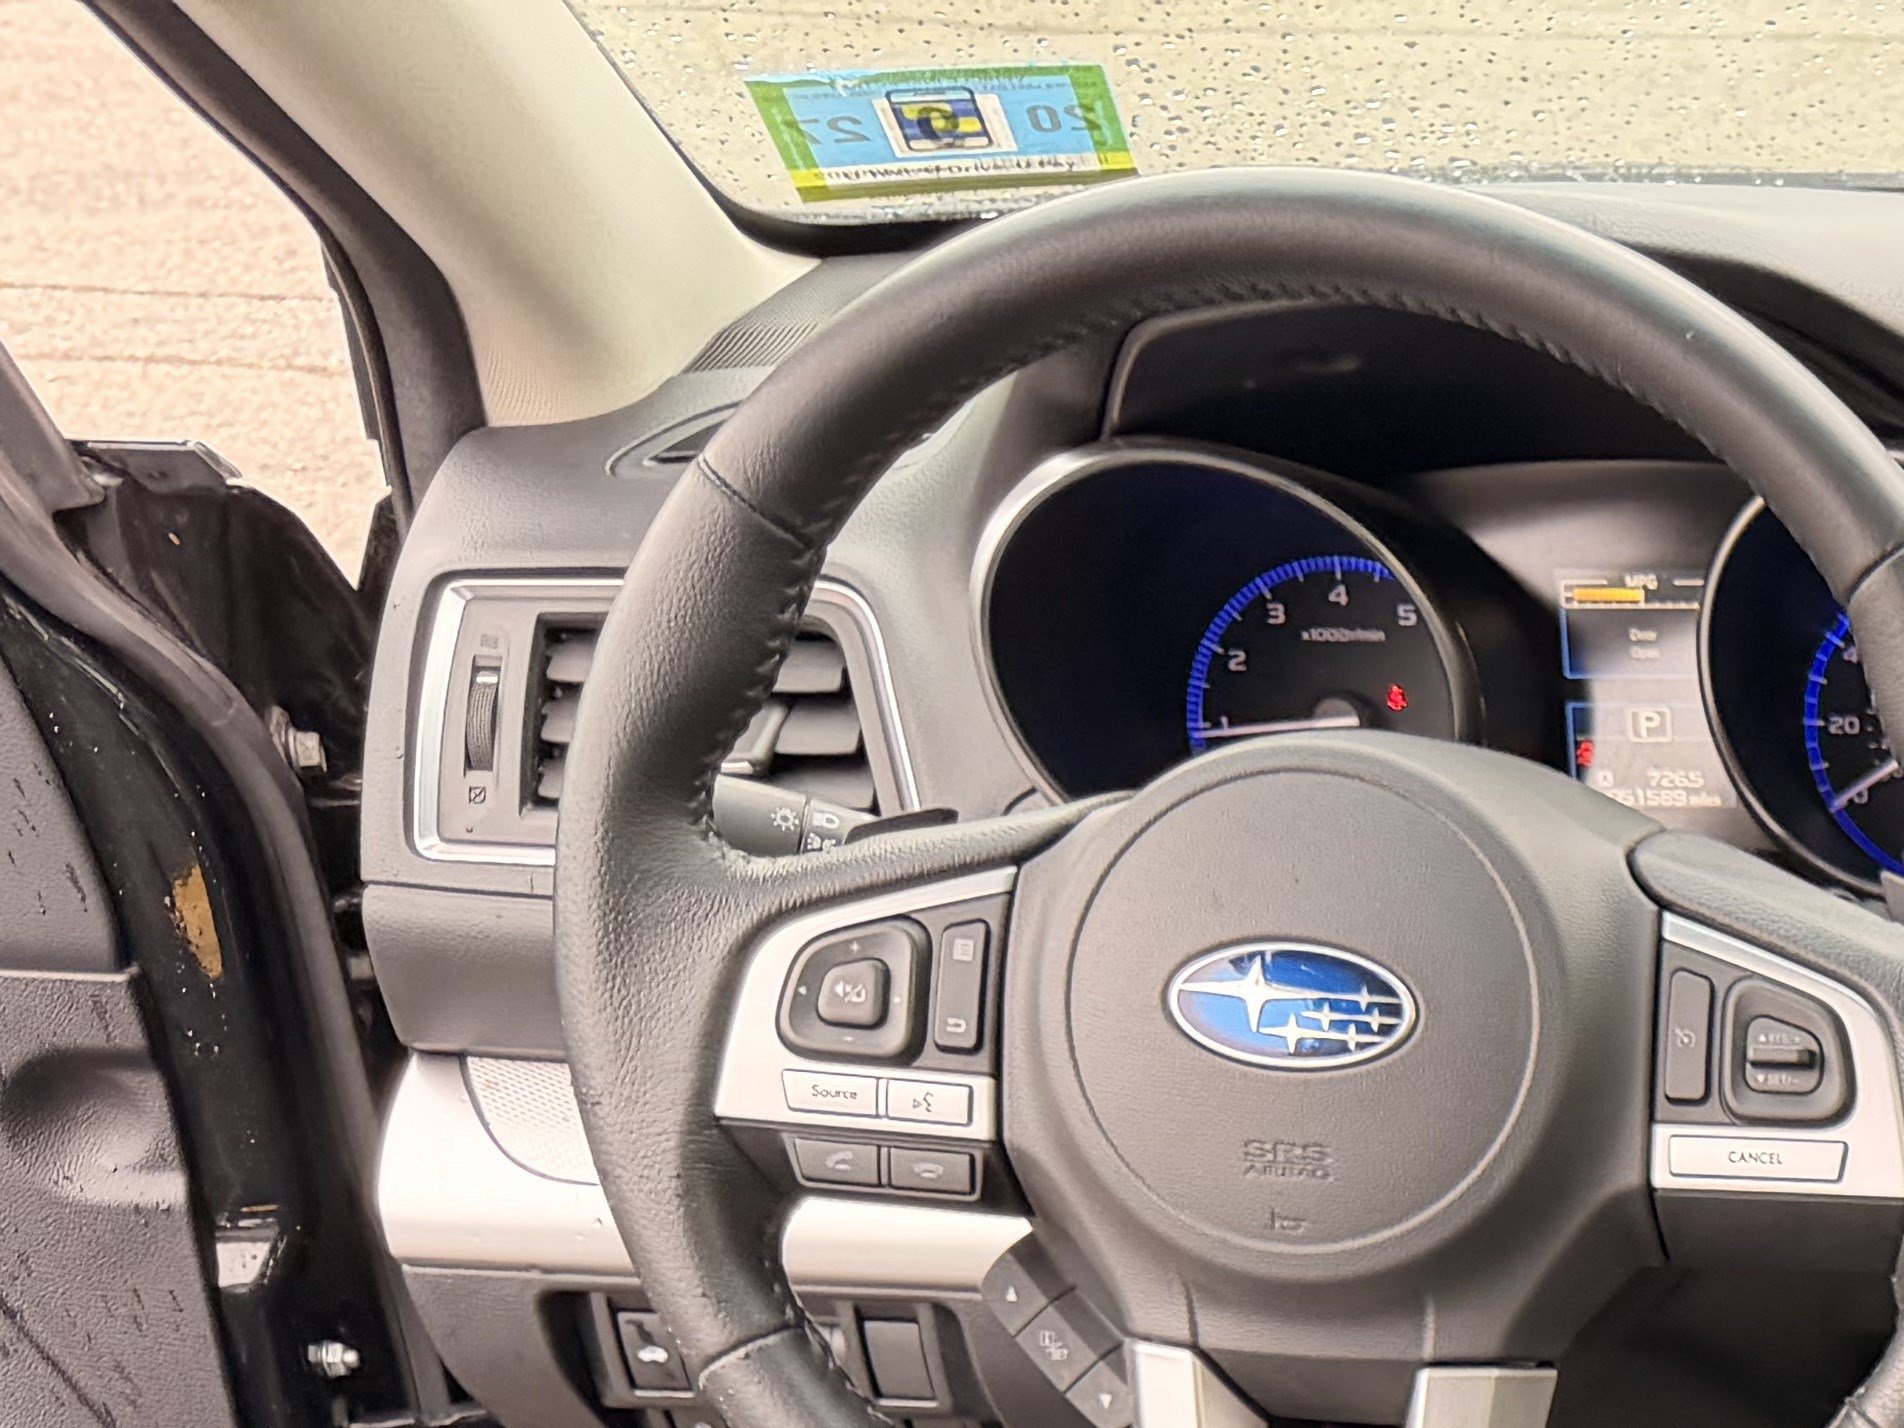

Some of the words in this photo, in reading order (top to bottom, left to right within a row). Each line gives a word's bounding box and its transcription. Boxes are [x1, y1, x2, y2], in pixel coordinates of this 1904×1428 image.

[1328, 584, 1349, 606] 4
[1266, 602, 1286, 625] 3
[1397, 602, 1418, 627] 5
[1228, 650, 1248, 672] 2
[1827, 716, 1861, 735] 20
[811, 1085, 857, 1099] Source
[1728, 1150, 1783, 1166] CANCEL
